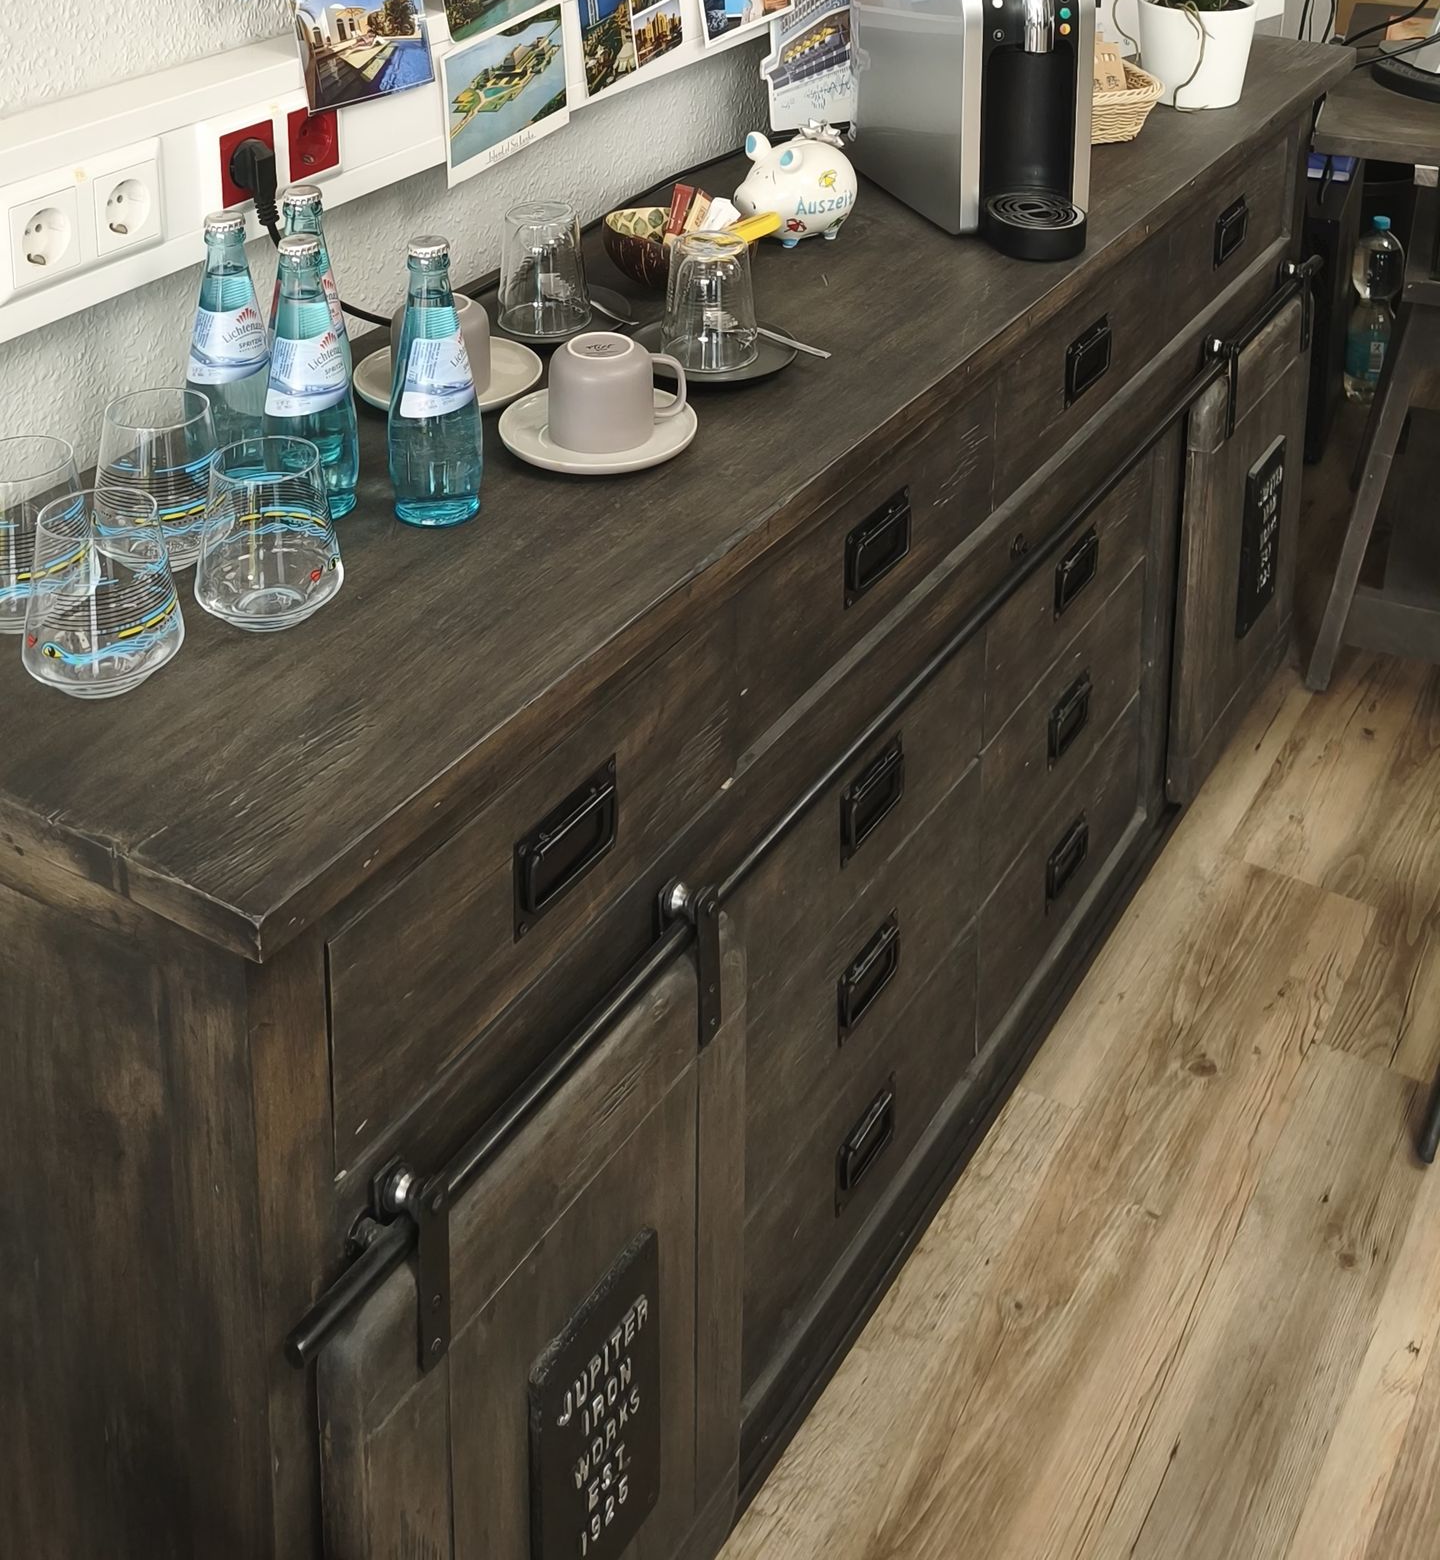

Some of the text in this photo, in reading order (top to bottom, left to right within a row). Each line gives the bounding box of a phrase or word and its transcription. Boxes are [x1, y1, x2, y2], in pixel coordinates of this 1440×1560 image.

[795, 190, 853, 216] Auszeit
[557, 1294, 648, 1427] JUPITER
[582, 1357, 632, 1436] IRON
[575, 1386, 640, 1489] WORKS
[581, 1474, 628, 1557] 1925
